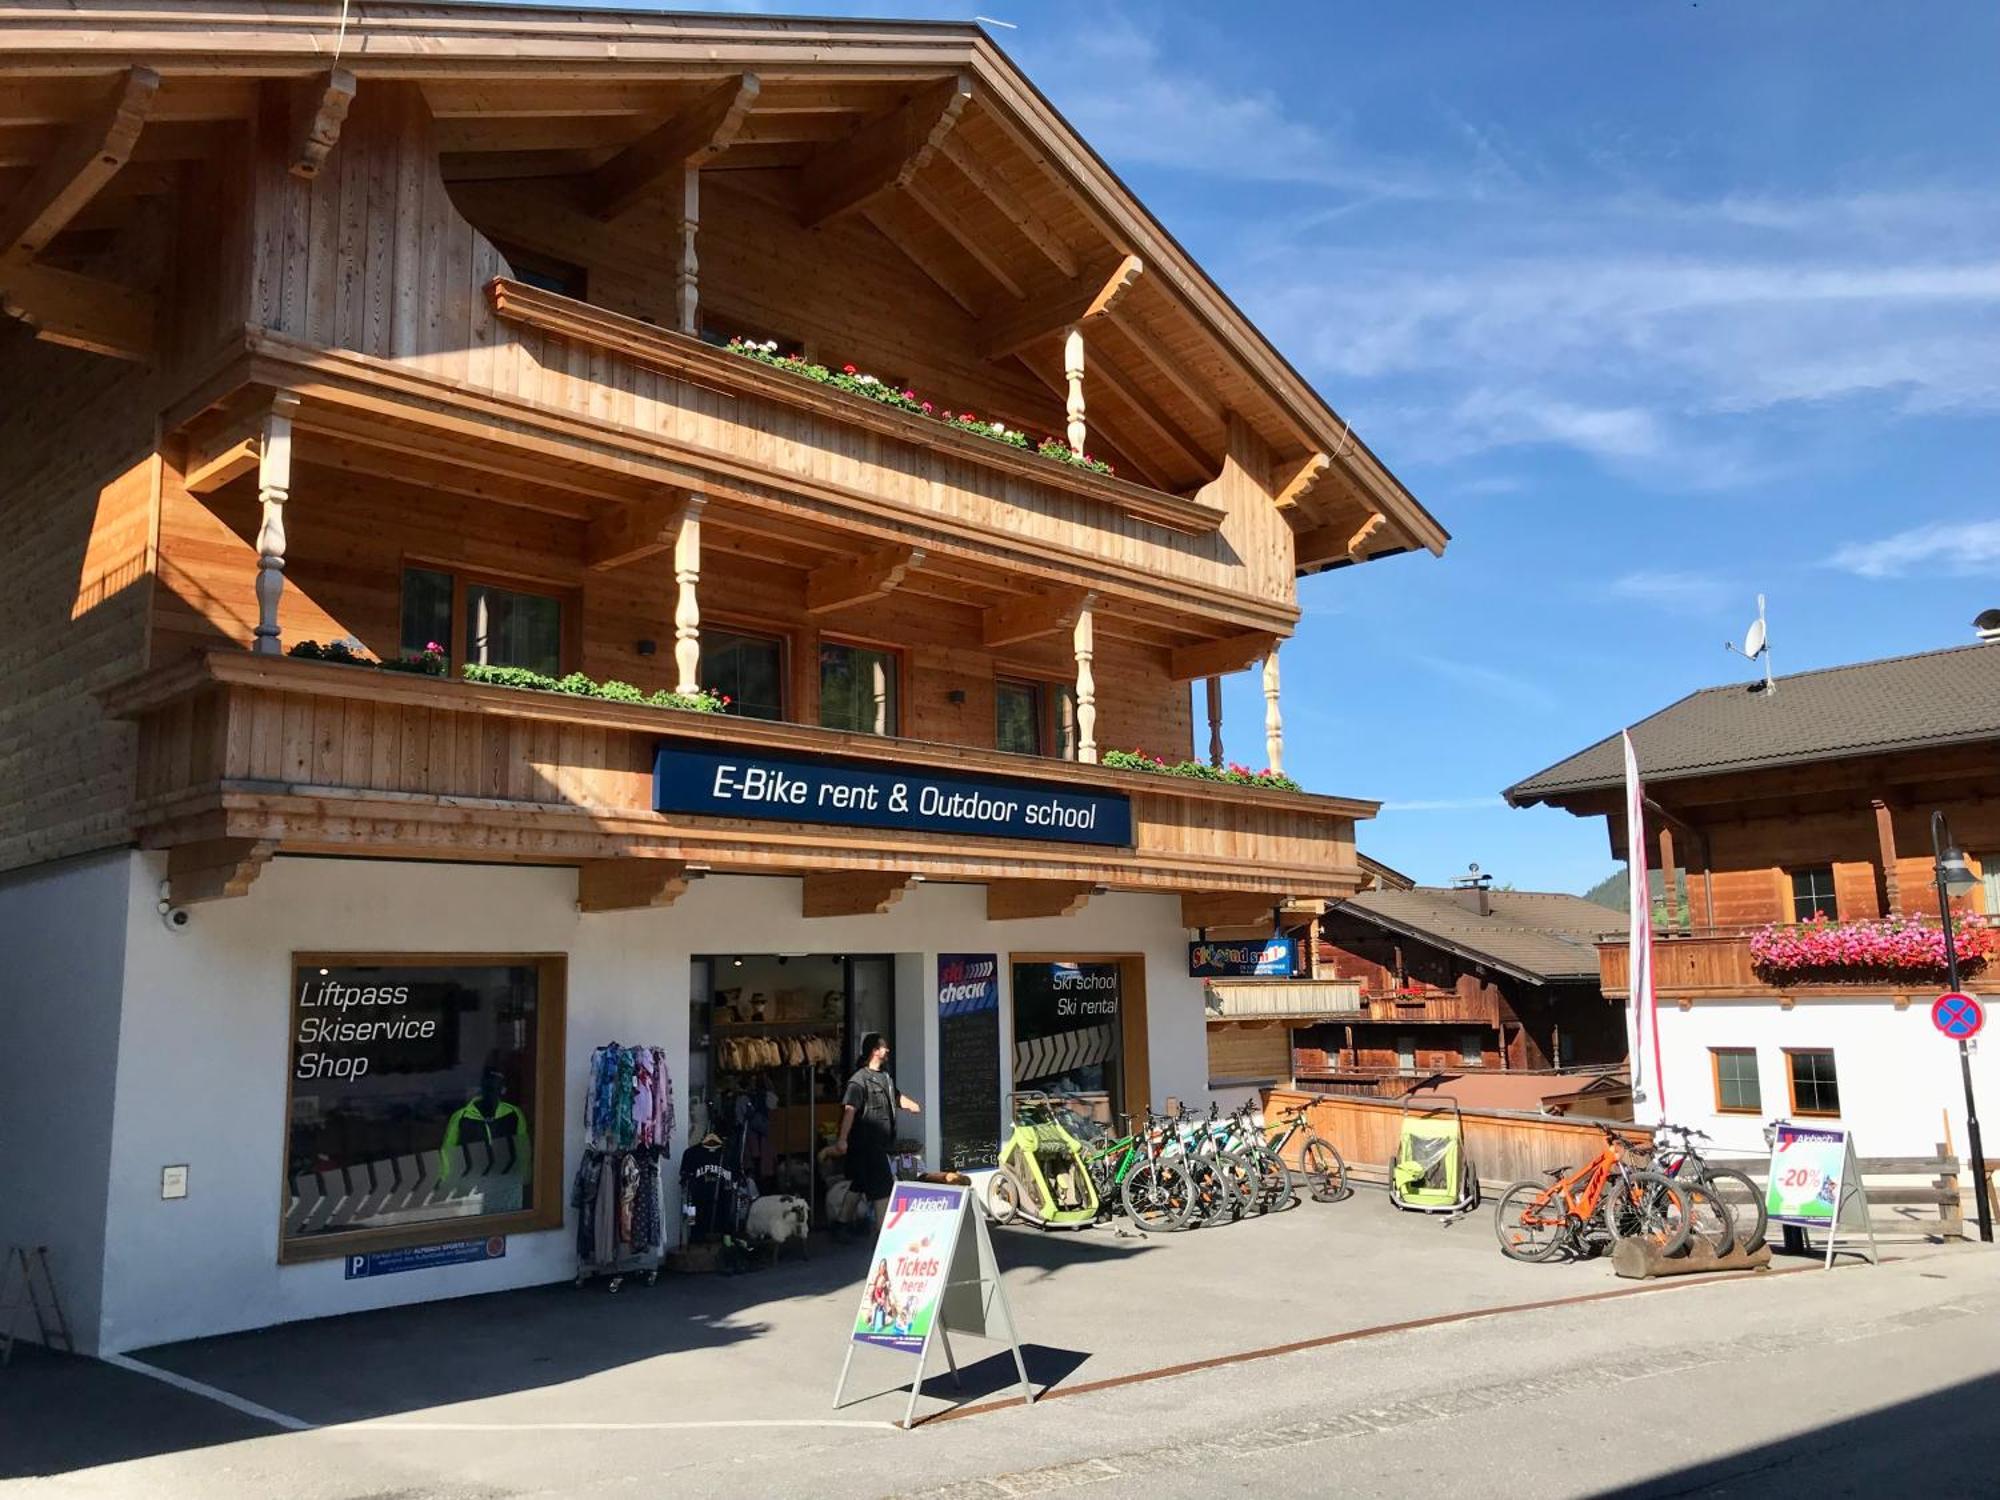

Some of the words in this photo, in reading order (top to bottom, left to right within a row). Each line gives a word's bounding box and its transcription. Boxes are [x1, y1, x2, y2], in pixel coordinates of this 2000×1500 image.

[713, 765, 808, 804] E-Bike
[818, 784, 878, 811] rent
[888, 783, 909, 813] &
[919, 787, 1018, 822] Outdoor
[1024, 800, 1096, 829] school
[1053, 973, 1072, 990] Ski
[1076, 972, 1117, 989] school
[300, 981, 409, 1012] Liftpass
[1057, 998, 1077, 1016] Ski
[1081, 998, 1118, 1014] rental
[298, 1015, 436, 1044] Skiservice
[296, 1053, 369, 1082] Shop
[1778, 1168, 1821, 1187] -20%
[352, 1256, 364, 1273] P
[896, 1256, 939, 1277] Tickets
